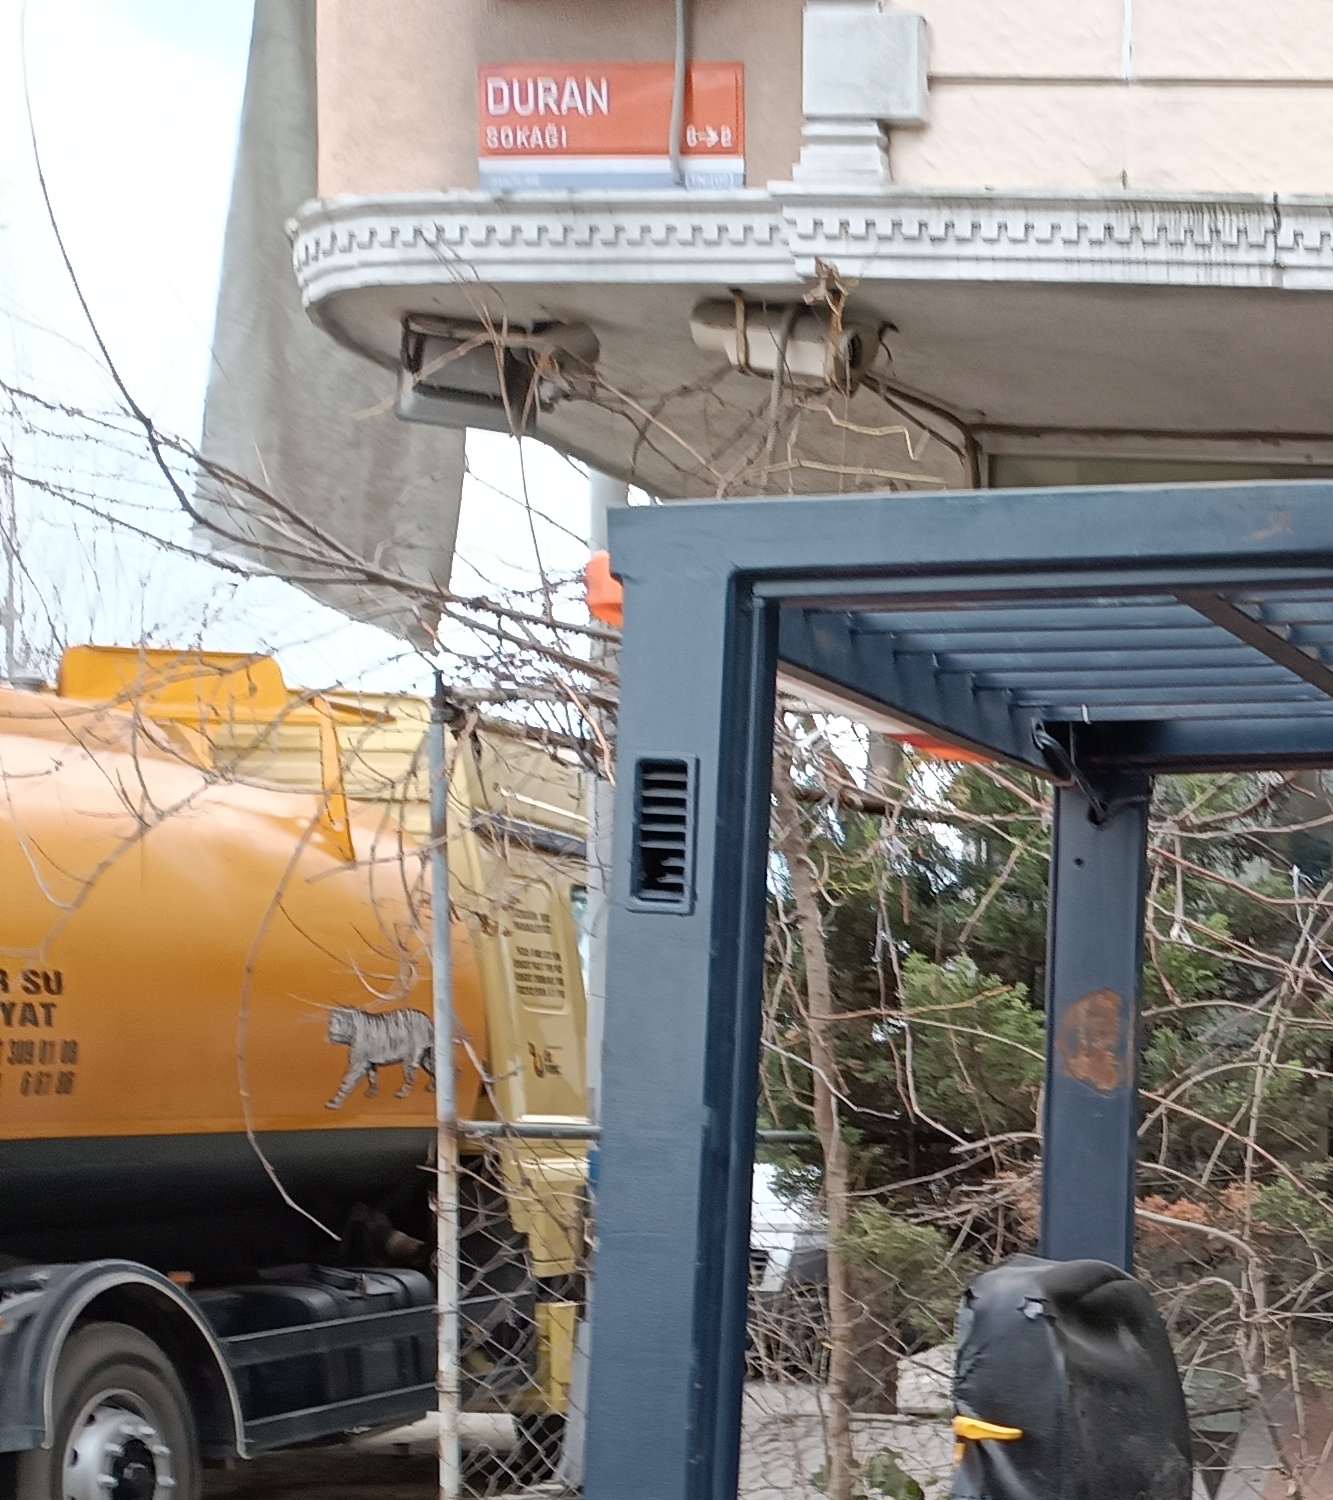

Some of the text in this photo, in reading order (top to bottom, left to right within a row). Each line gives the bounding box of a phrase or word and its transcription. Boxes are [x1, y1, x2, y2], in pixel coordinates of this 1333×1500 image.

[486, 76, 609, 117] DURAN
[486, 121, 568, 150] SOKAĞI
[21, 968, 63, 995] SU
[0, 1002, 57, 1028] YAT
